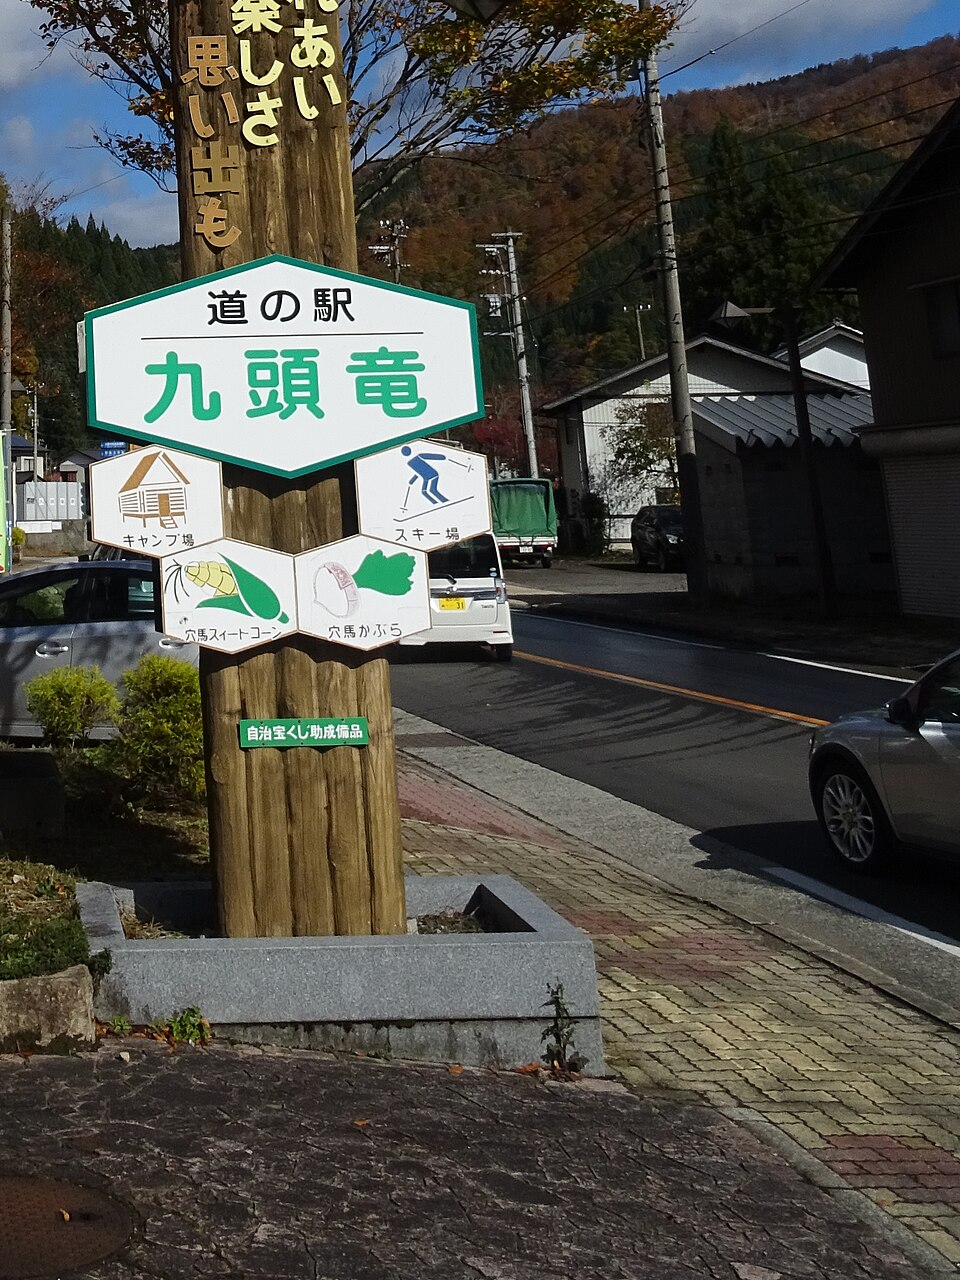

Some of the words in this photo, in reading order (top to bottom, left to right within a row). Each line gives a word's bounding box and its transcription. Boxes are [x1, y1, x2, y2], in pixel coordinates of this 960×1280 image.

[181, 35, 242, 248] 思い出も
[207, 288, 355, 325] 道の駅
[144, 346, 428, 423] 九頭竜
[123, 533, 195, 548] キャンプ場
[395, 527, 460, 542] スキー場
[328, 622, 403, 639] 穴馬かぶら
[247, 723, 363, 741] 自治宝くじ助成備品
